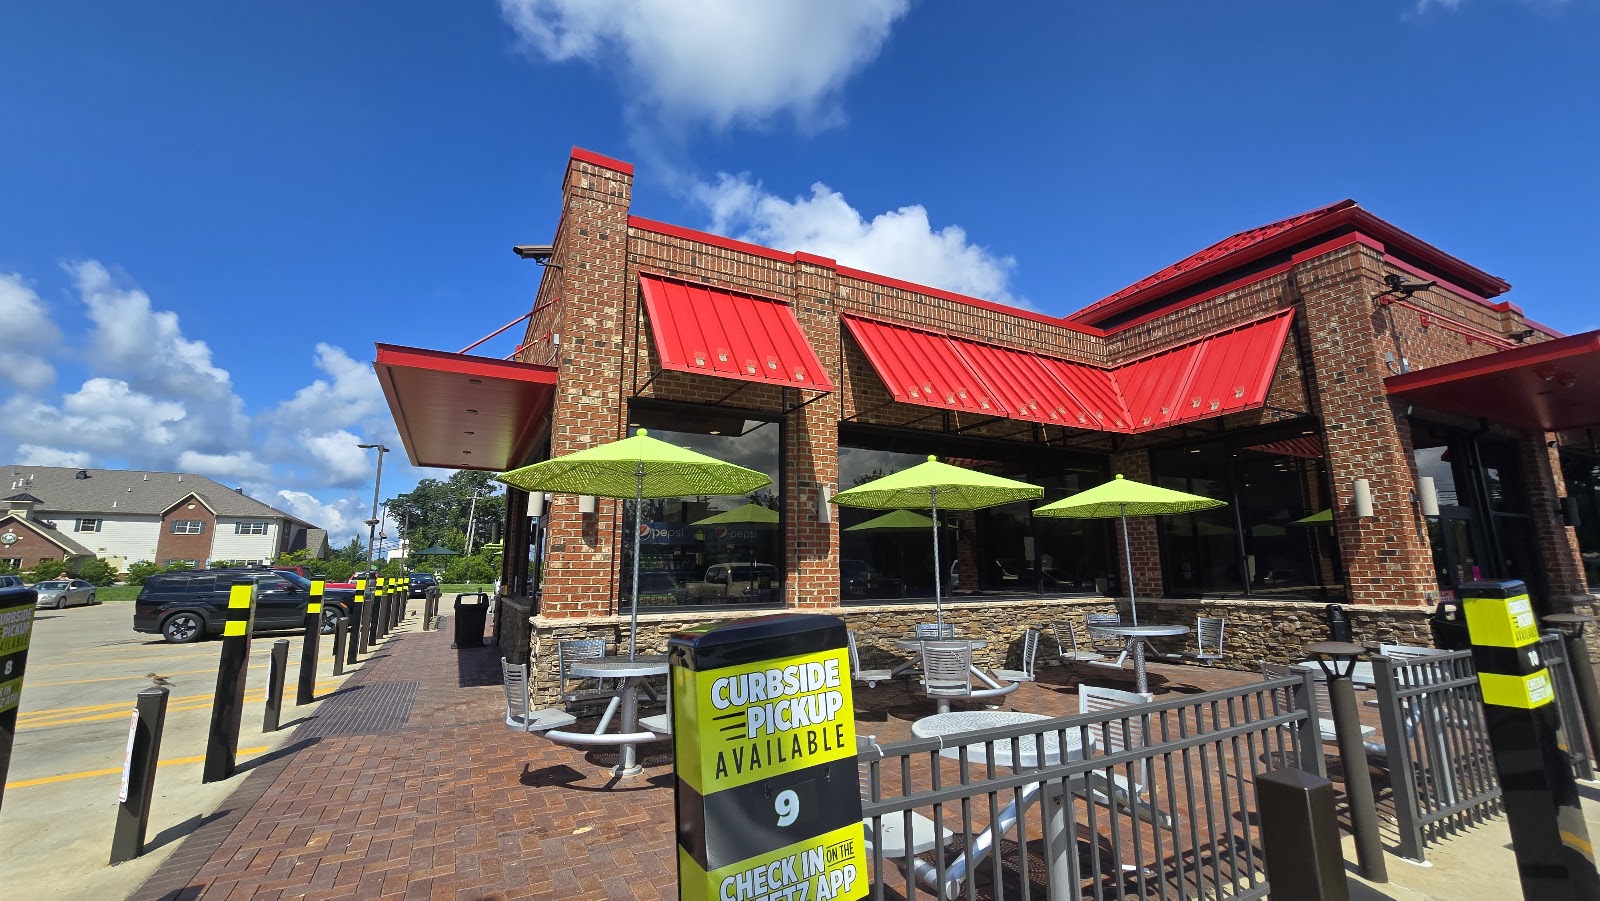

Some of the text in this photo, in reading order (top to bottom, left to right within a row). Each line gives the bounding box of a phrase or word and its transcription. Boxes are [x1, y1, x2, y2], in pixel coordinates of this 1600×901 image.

[651, 528, 684, 538] pepsi
[729, 529, 758, 538] pepsi
[0, 608, 32, 625] URBSIDE
[2, 621, 30, 639] PICKUP
[4, 660, 13, 675] 8
[1528, 651, 1539, 667] 10
[711, 658, 841, 710] CURBSIDE
[747, 690, 843, 739] PICKUP
[715, 723, 845, 780] AVAILABLE
[774, 789, 800, 827] 9
[719, 854, 799, 901] CHECK
[800, 844, 826, 880] IN
[825, 850, 838, 864] ON
[840, 841, 855, 859] THE
[816, 864, 857, 901] APP
